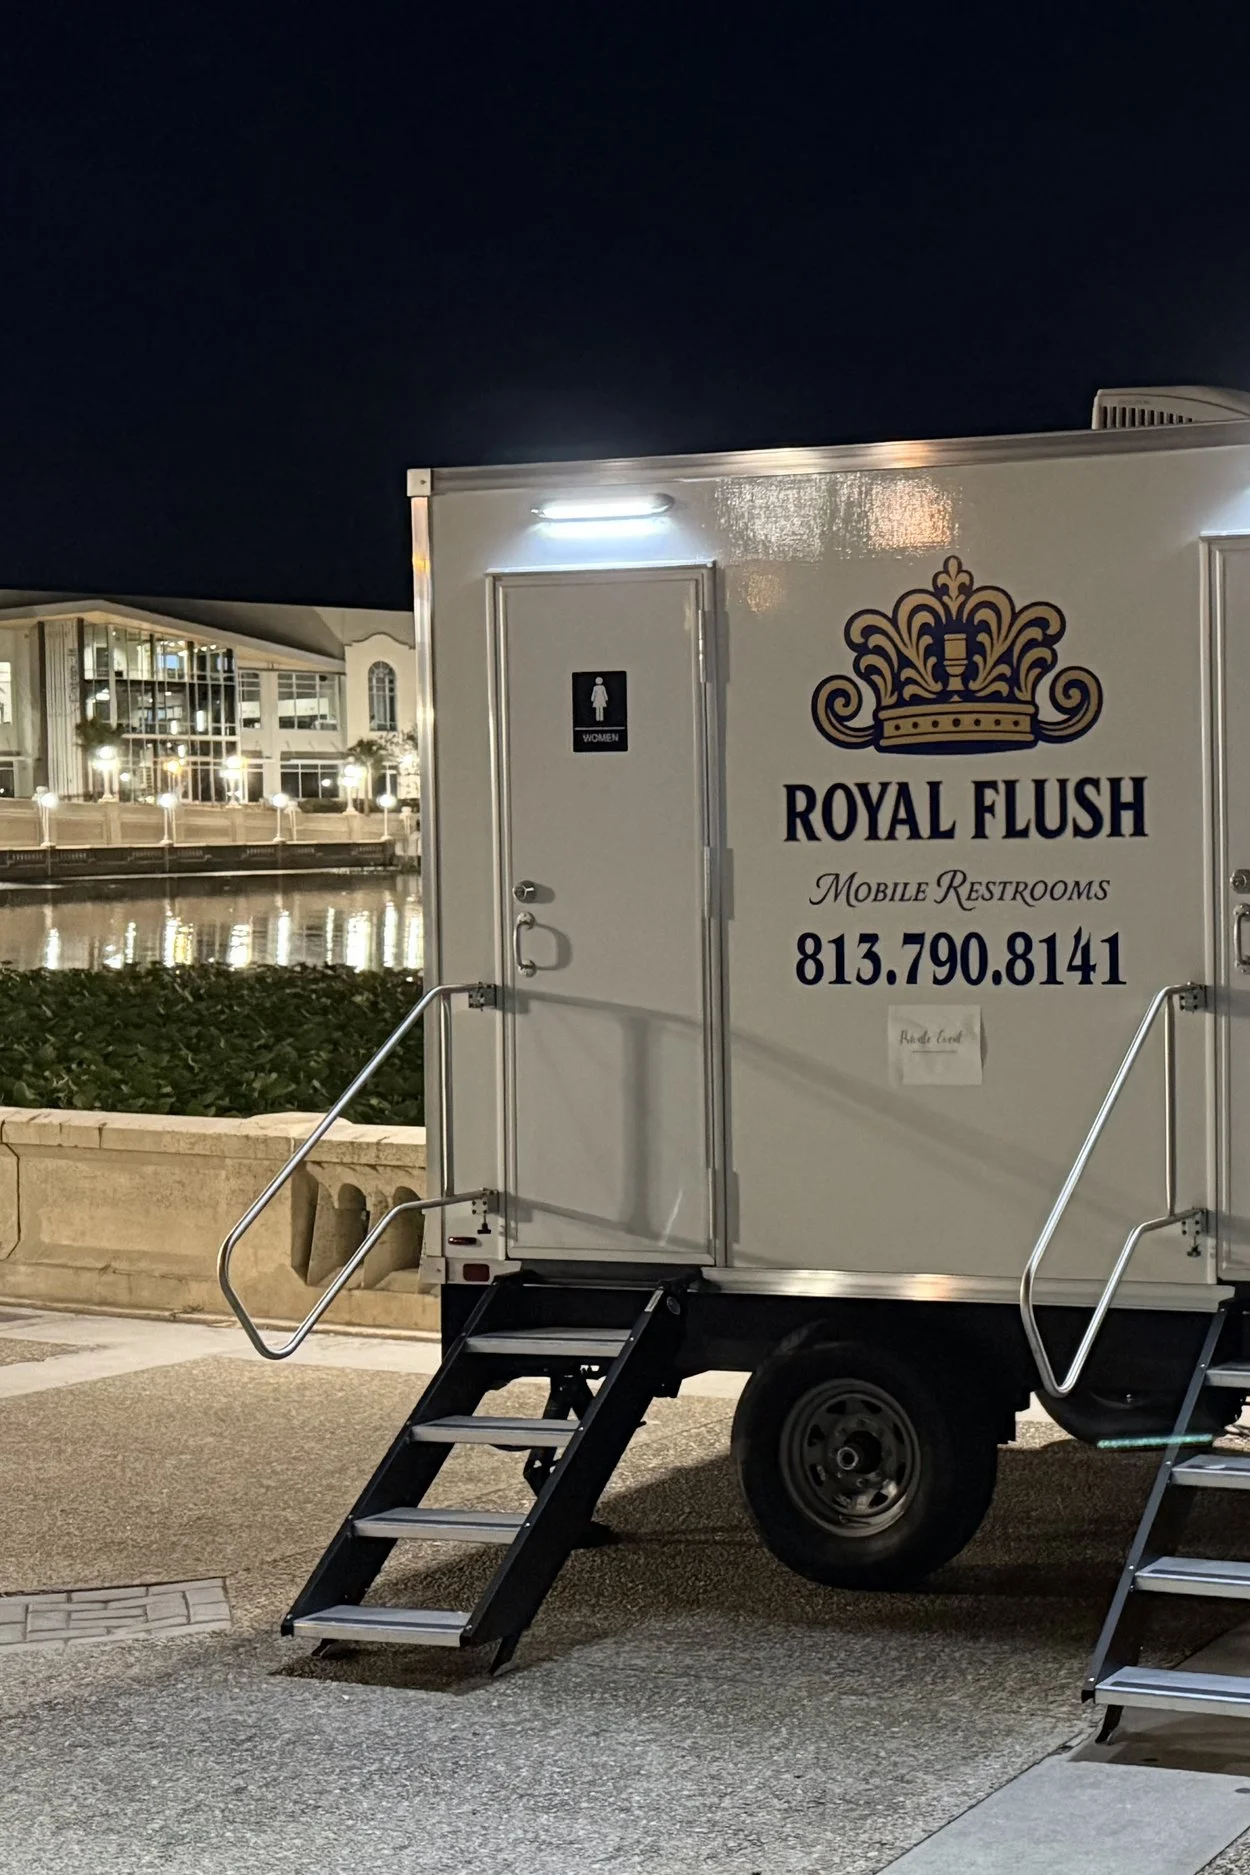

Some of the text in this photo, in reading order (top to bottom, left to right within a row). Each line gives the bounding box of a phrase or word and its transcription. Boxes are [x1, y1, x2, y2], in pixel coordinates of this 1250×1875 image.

[582, 733, 619, 743] WOMEN
[783, 776, 1149, 842] ROYAL FLUSH
[796, 925, 1127, 986] 813.790.8141
